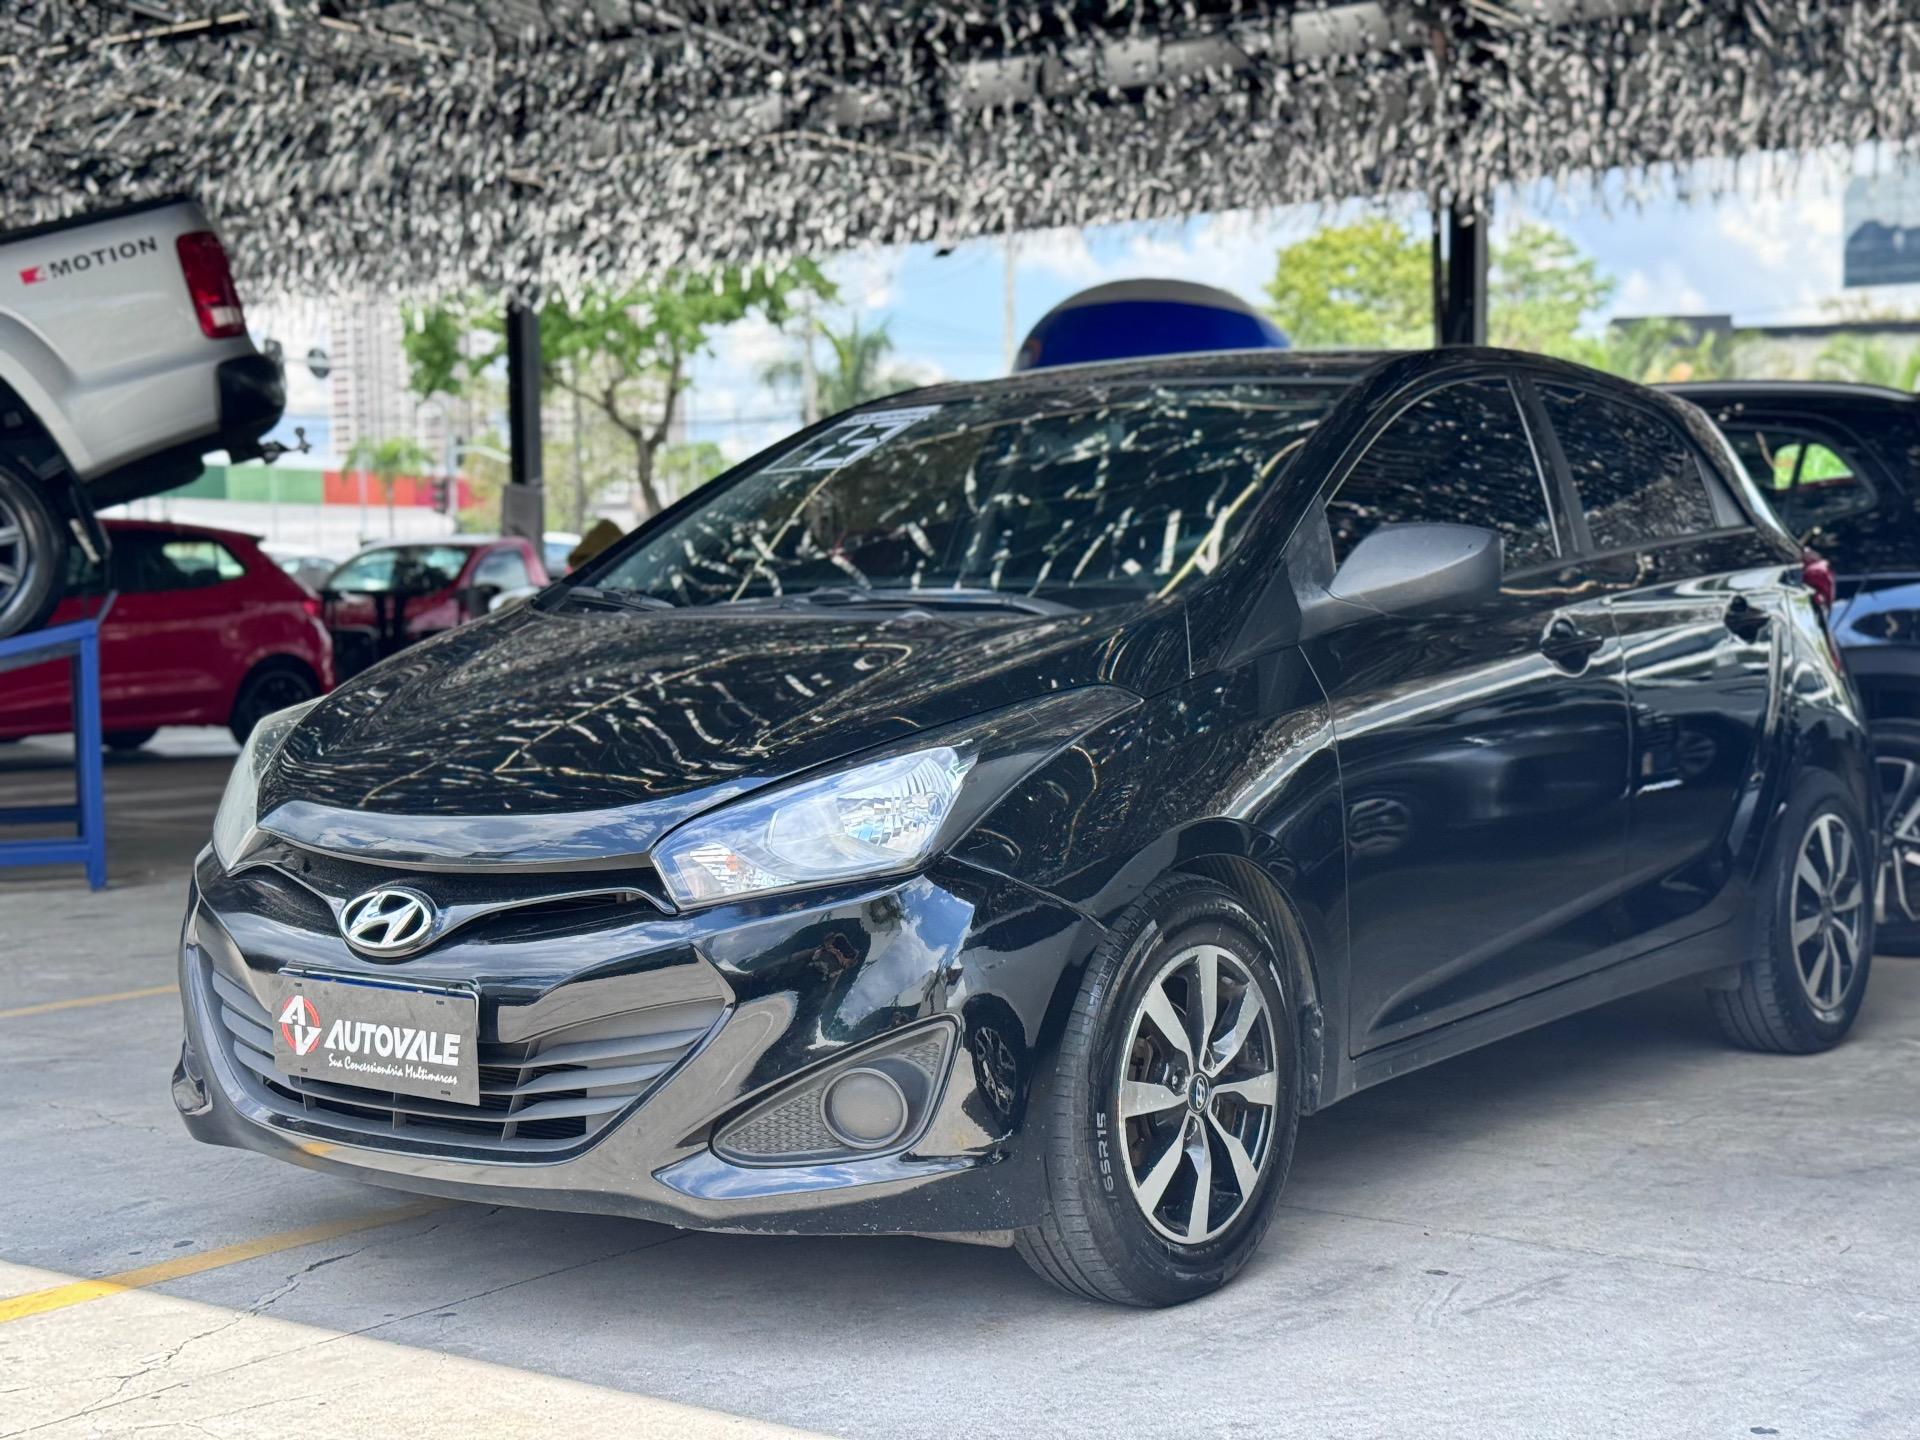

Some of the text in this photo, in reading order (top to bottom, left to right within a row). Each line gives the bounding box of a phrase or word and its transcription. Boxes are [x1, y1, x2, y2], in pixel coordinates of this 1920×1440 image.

[325, 1019, 461, 1065] AUTOVALE
[328, 1053, 343, 1068] Sua
[405, 1064, 457, 1085] Multimarcas
